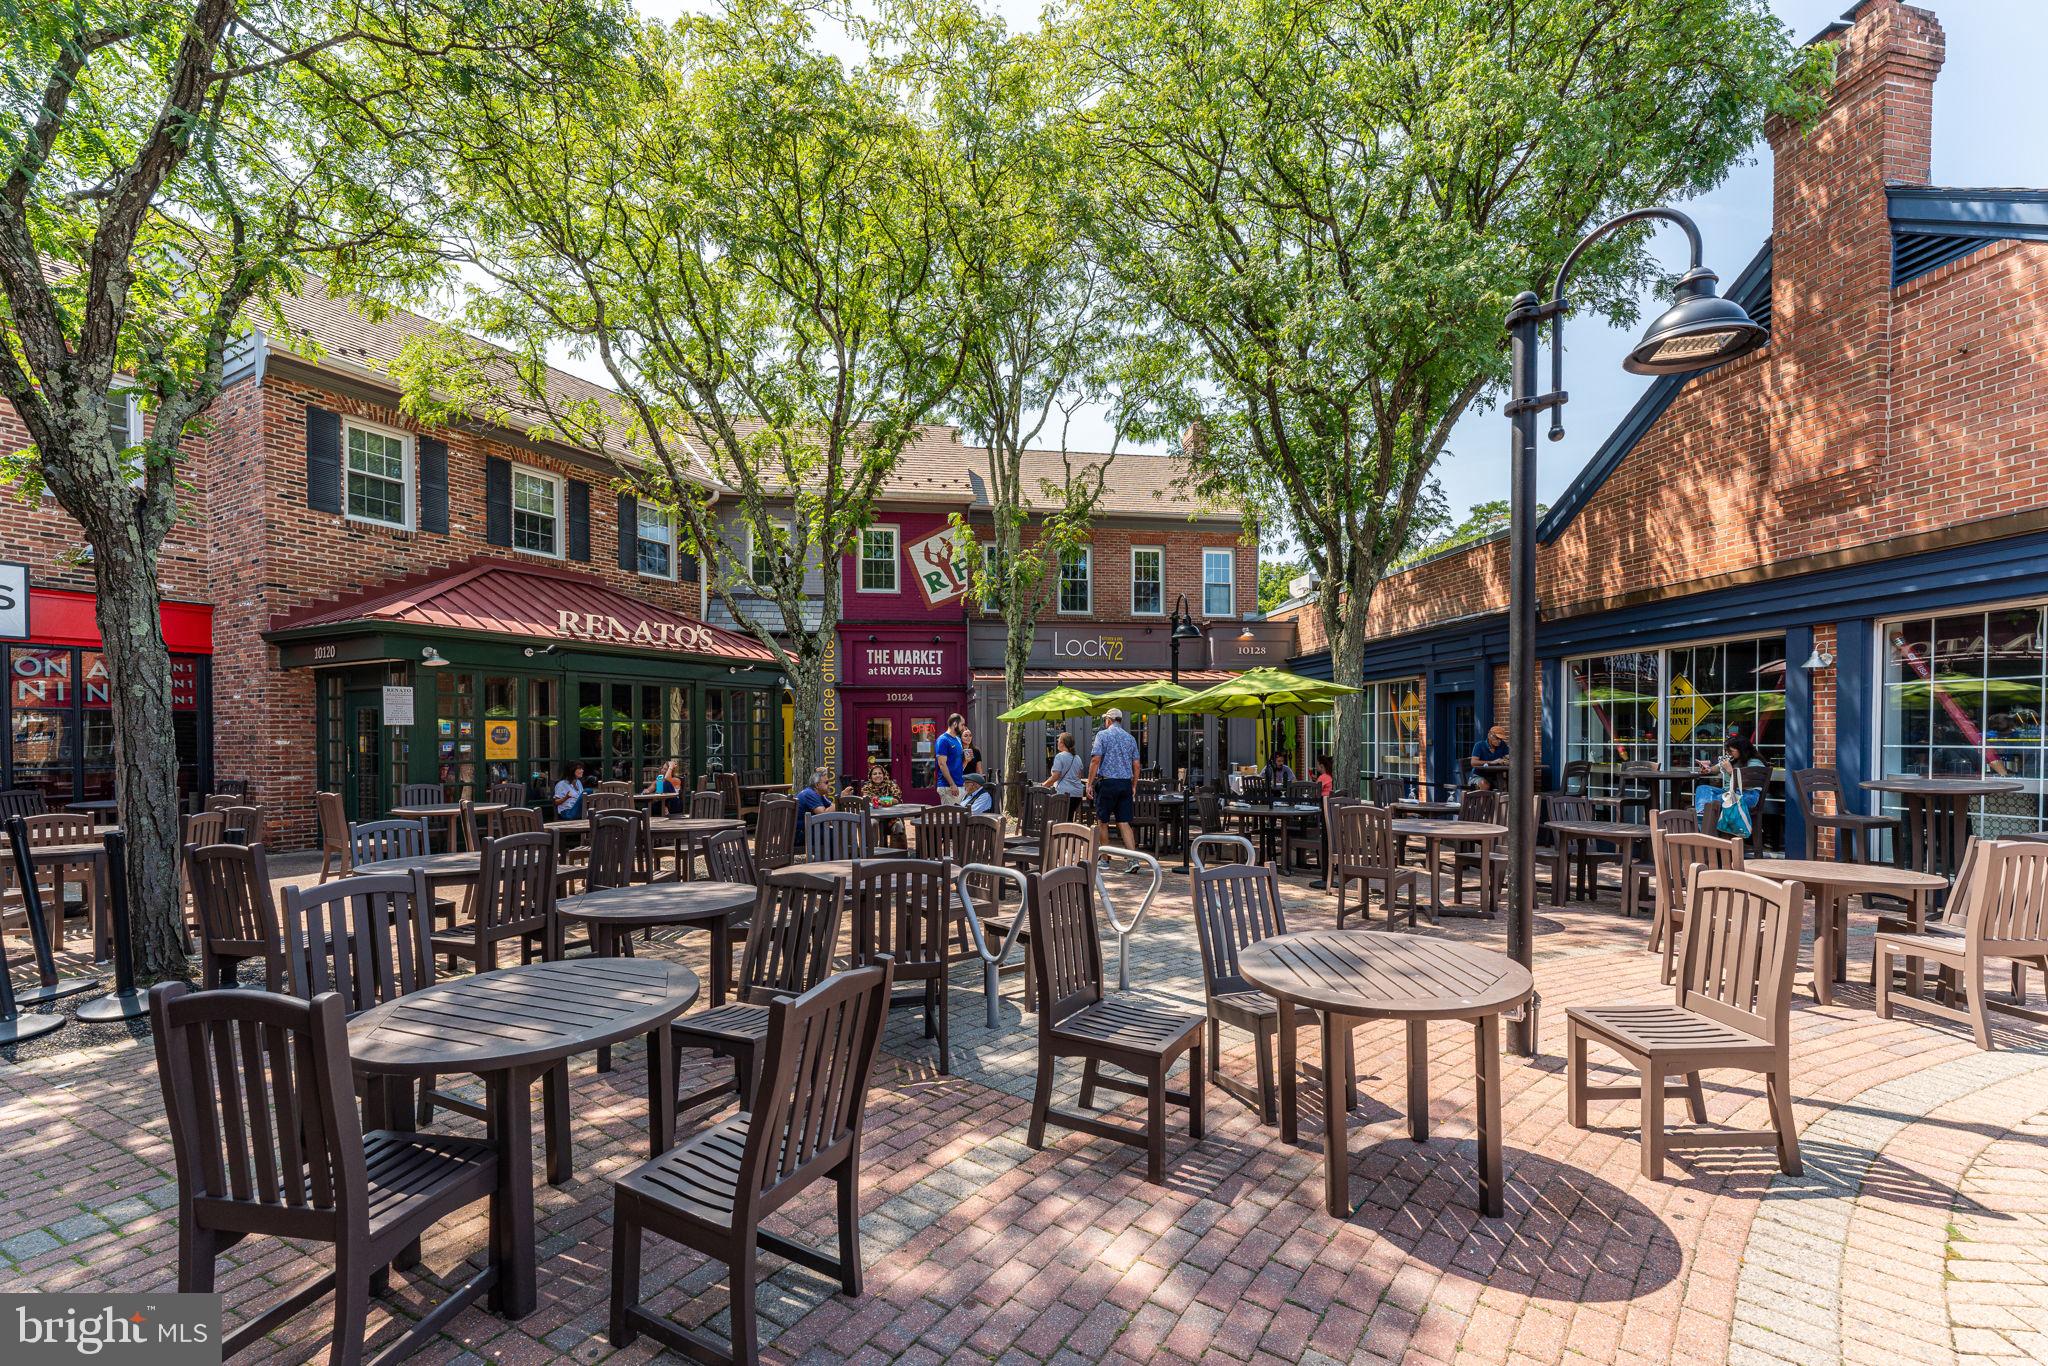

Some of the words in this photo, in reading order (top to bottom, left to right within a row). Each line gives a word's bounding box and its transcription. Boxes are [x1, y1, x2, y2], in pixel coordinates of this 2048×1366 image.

[556, 609, 714, 648] RENATO'S
[314, 645, 336, 659] 10120
[866, 649, 890, 665] THE
[893, 649, 943, 665] MARKET
[1238, 646, 1266, 655] 10128
[868, 667, 878, 676] at
[880, 666, 911, 676] RIVER
[913, 666, 942, 676] FALLS
[886, 693, 913, 702] 10124
[820, 688, 839, 731] place
